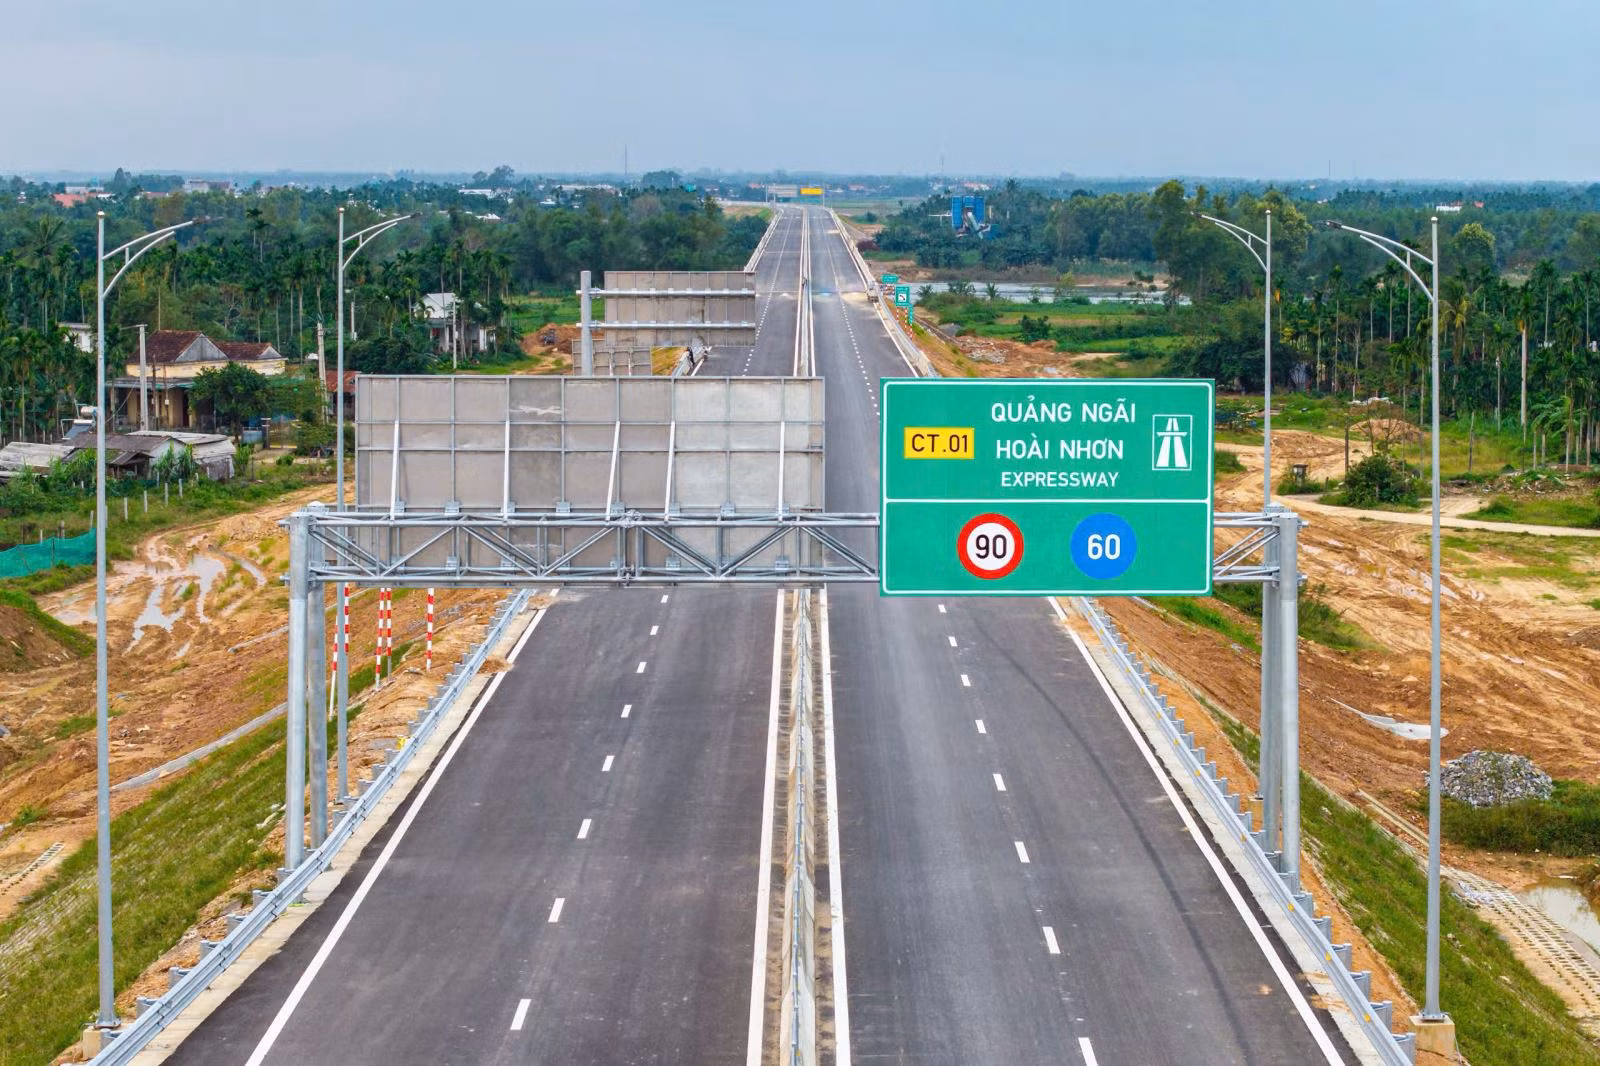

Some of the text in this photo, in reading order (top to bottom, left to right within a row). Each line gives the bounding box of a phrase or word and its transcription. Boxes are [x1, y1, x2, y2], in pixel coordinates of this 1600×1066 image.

[991, 394, 1136, 423] QUẢNG NGÃI
[911, 433, 968, 453] CT.01
[996, 432, 1124, 460] HOÀI NHƠN
[1001, 471, 1119, 487] EXPRESSWAY
[975, 534, 1007, 560] 90
[1087, 533, 1121, 560] 60
